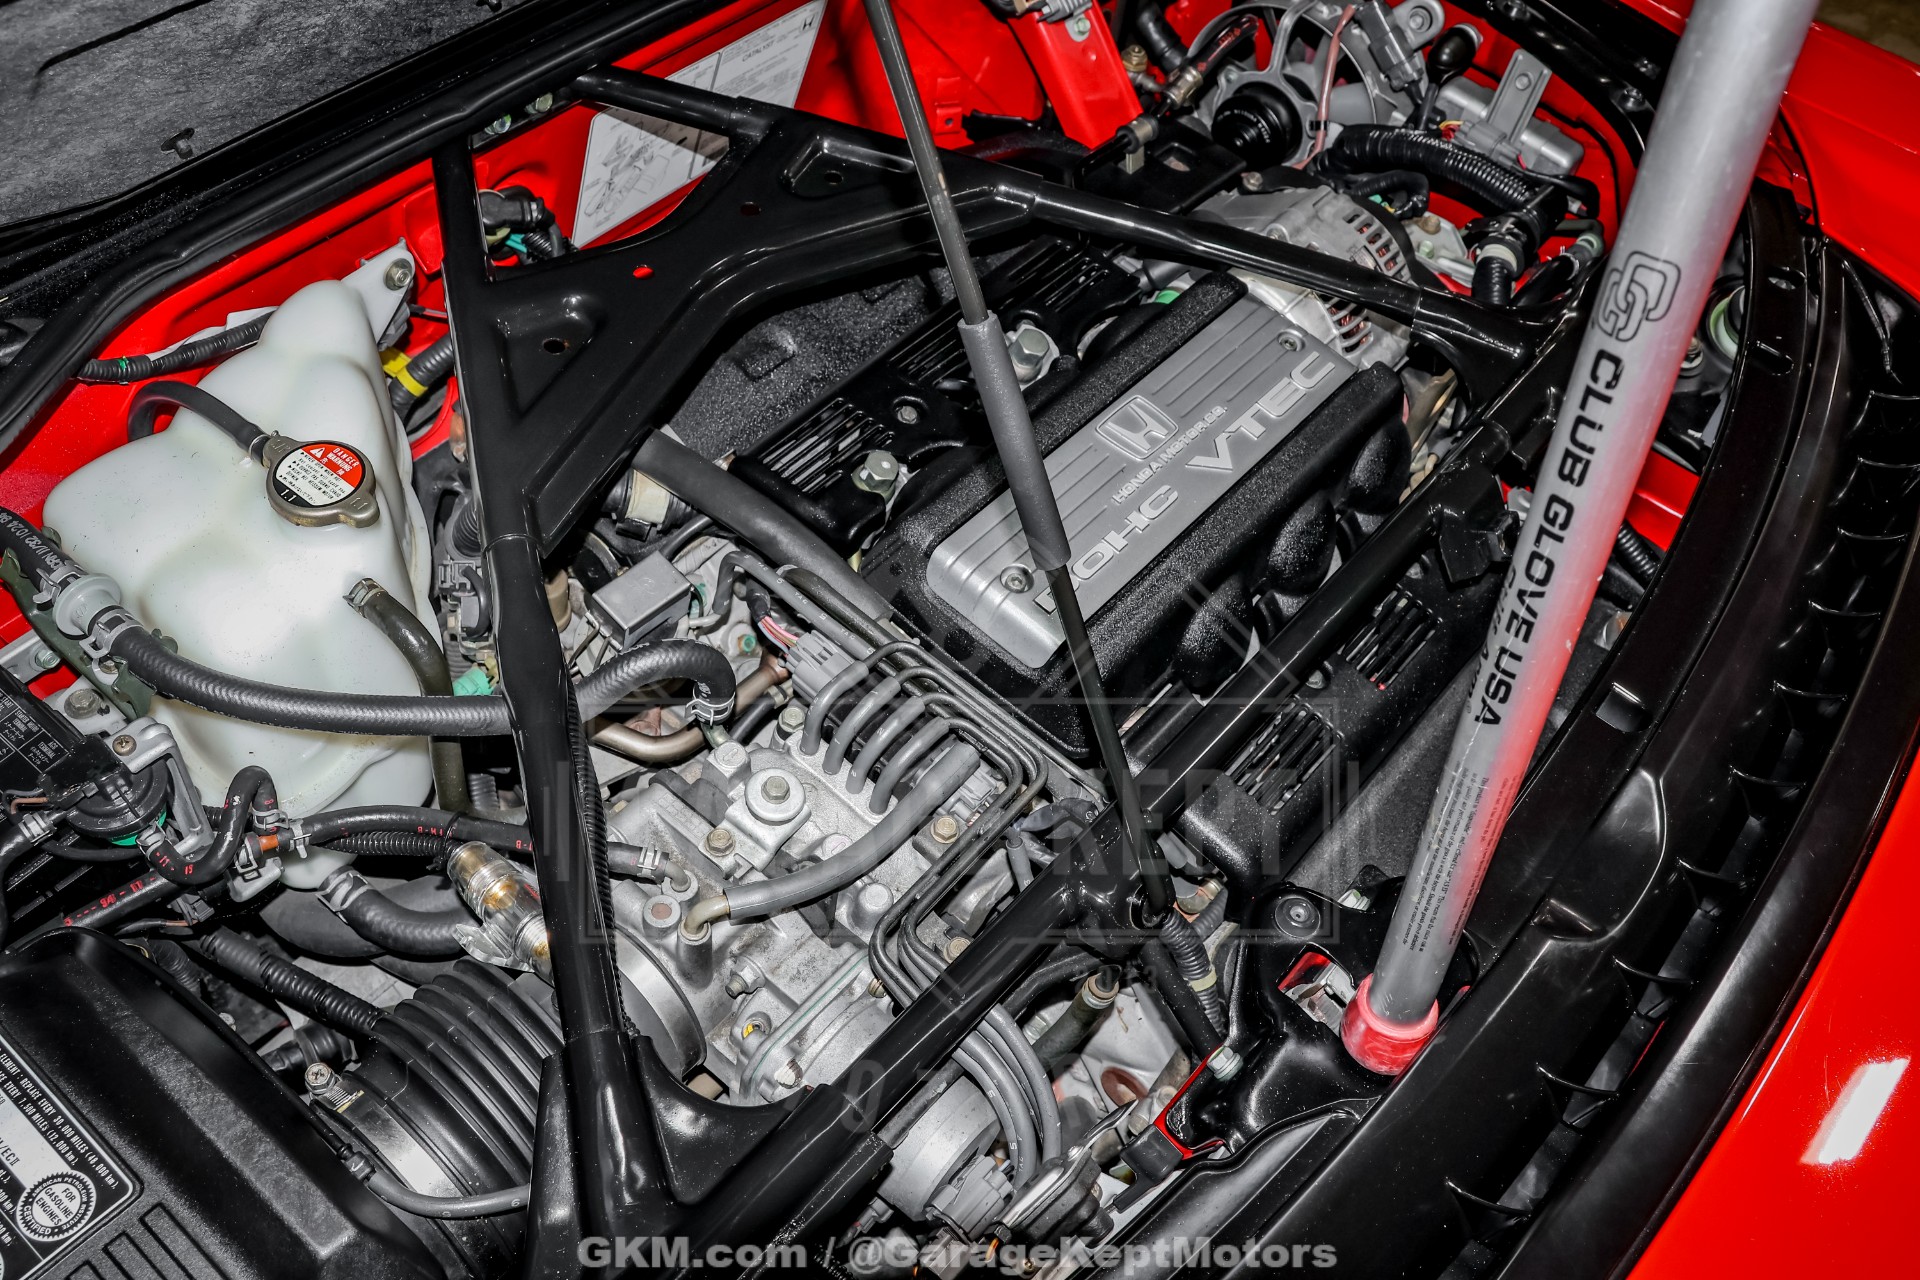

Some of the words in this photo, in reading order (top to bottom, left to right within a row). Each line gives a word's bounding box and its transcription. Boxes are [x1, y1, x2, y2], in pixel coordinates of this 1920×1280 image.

[1185, 350, 1336, 472] VTEC
[1557, 348, 1624, 488] CLUB
[333, 447, 358, 467] DANGER
[1111, 457, 1163, 505] HONDA
[1162, 420, 1208, 463] MOTOR
[281, 488, 296, 502] 1.1
[1505, 493, 1575, 644] GLOVE
[1474, 645, 1523, 726] USA
[4, 1081, 20, 1098] EVERY
[18, 1098, 35, 1115] 7,500
[31, 1113, 48, 1131] MILES
[46, 1129, 68, 1152] (12,000
[20, 1077, 41, 1100] REPLACE
[38, 1098, 55, 1116] EVERY
[53, 1115, 74, 1137] 30,000
[70, 1135, 87, 1153] MILES
[32, 1177, 62, 1197] AMERICAN
[64, 1176, 88, 1202] PETROLEUM
[35, 1197, 62, 1226] ENGINES
[44, 1187, 74, 1219] GASOLINE
[61, 1187, 77, 1203] FOR
[23, 1205, 52, 1235] CERTIFIED
